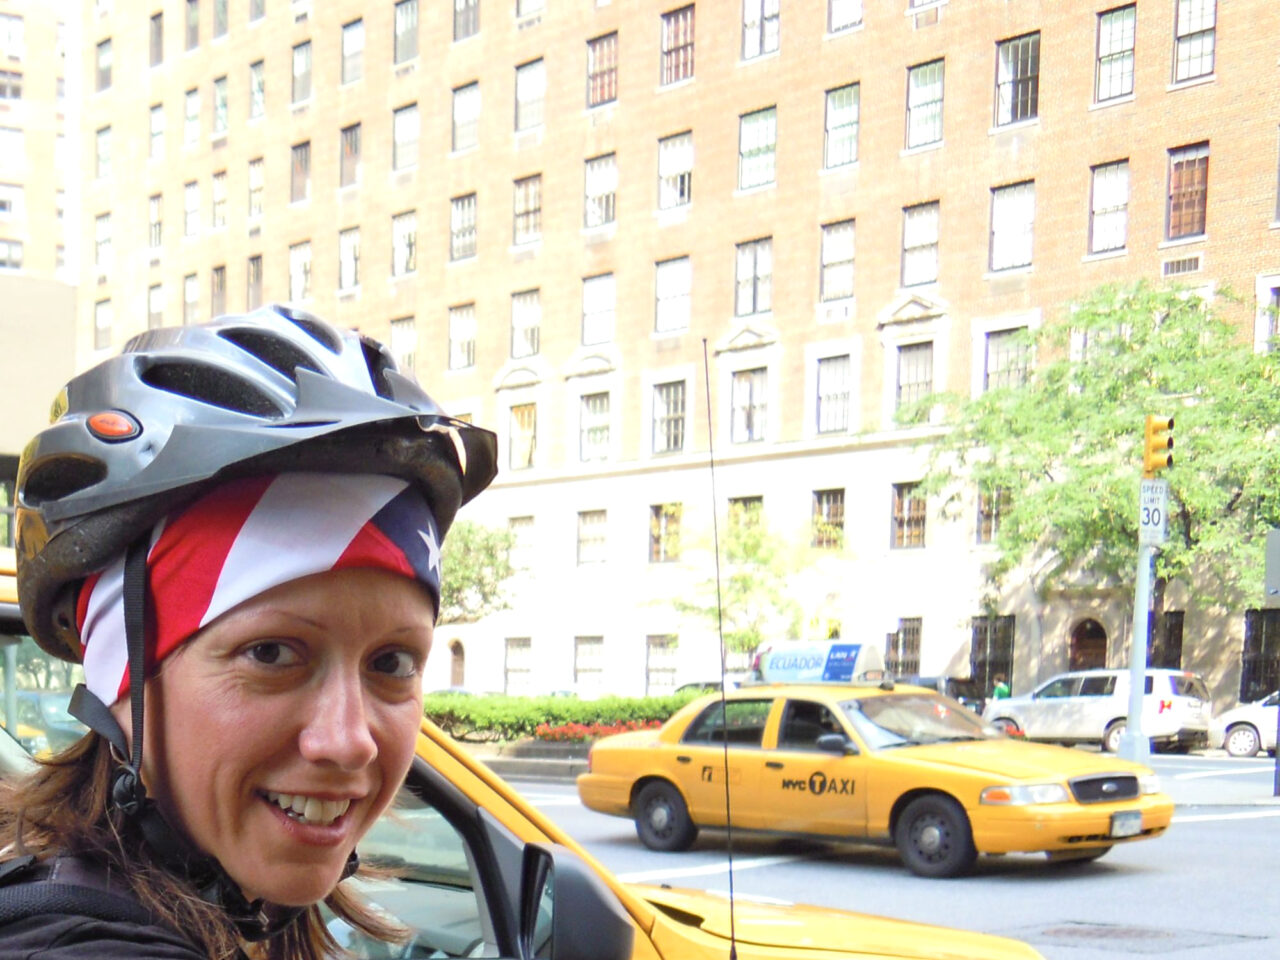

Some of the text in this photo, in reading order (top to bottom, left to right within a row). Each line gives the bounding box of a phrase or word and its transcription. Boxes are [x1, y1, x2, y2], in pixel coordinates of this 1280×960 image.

[1142, 485, 1163, 494] SPEED
[1142, 507, 1161, 526] 30
[769, 655, 823, 671] ECUADOR
[782, 771, 855, 796] NYC TAXI
